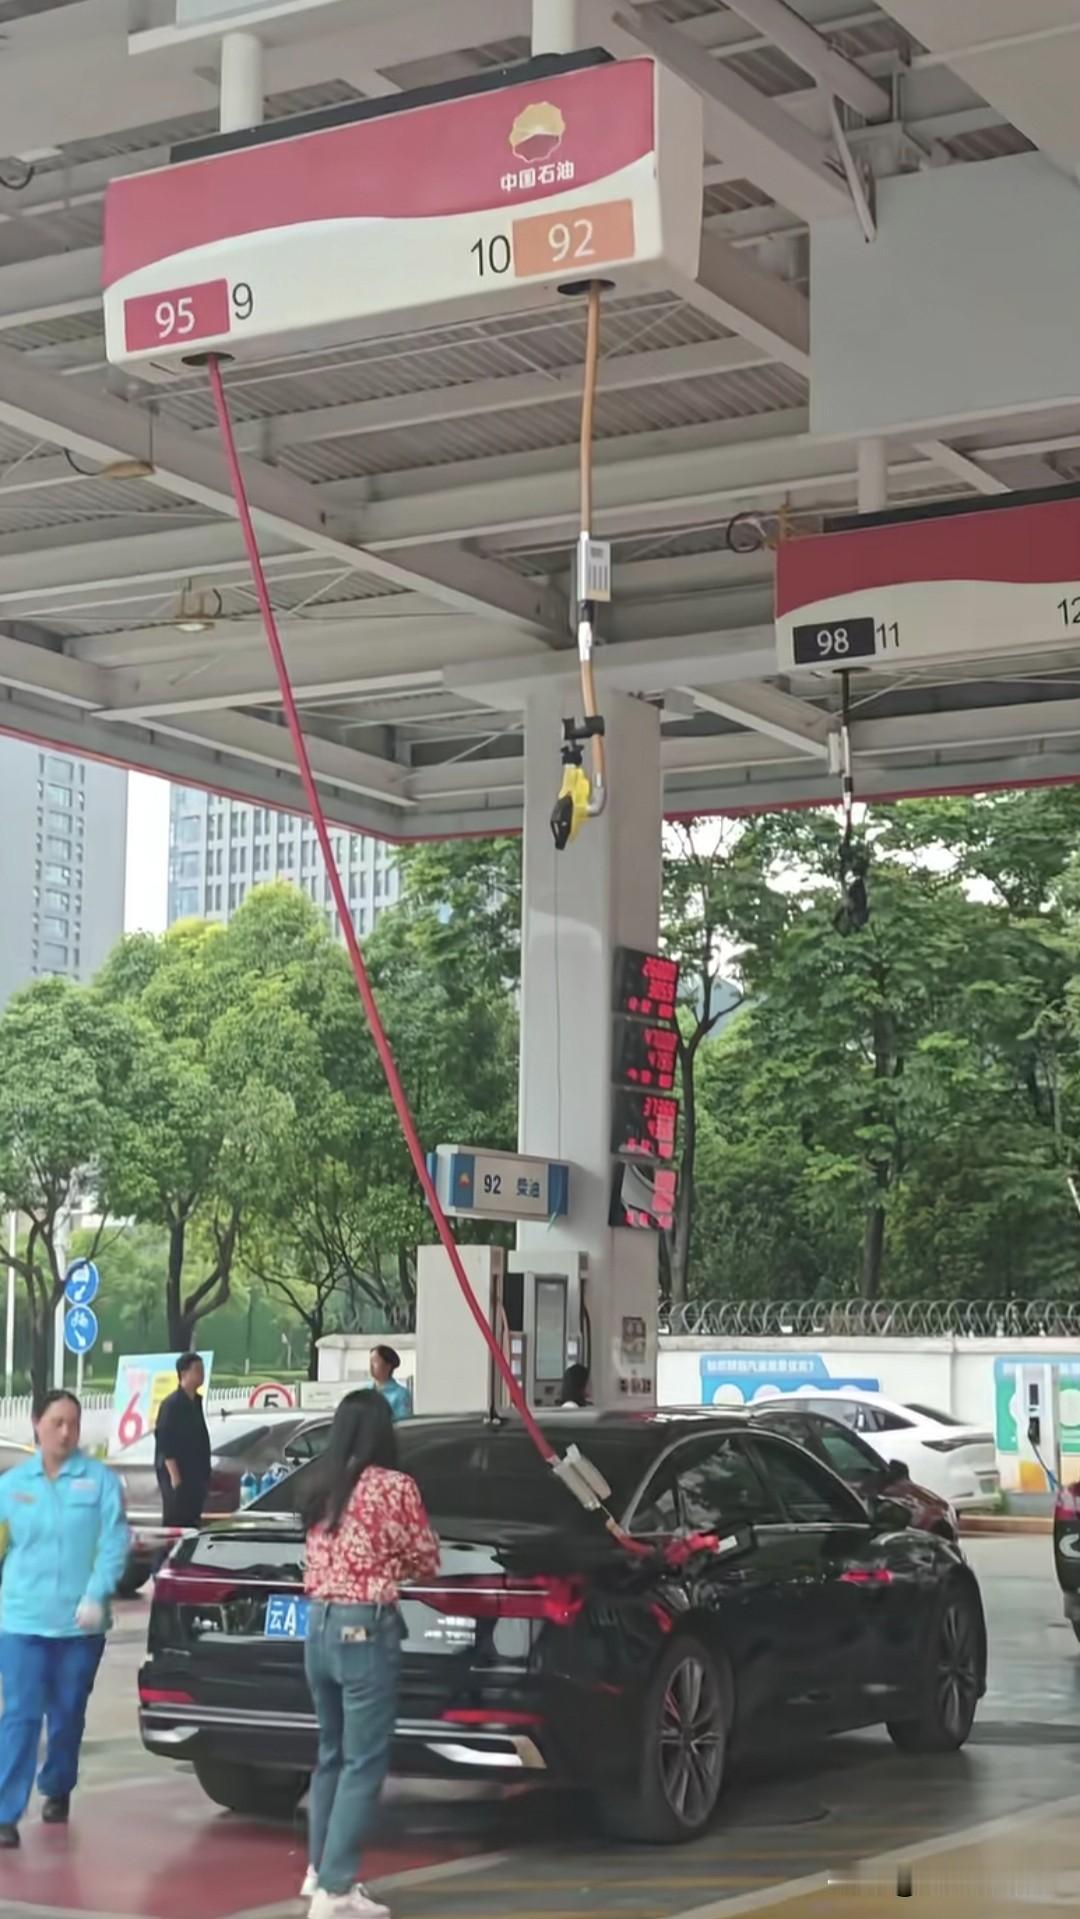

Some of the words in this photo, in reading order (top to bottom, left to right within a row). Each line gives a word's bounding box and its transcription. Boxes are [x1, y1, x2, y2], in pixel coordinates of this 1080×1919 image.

[501, 160, 574, 192] 中国石油
[470, 234, 512, 277] 10
[548, 219, 595, 262] 92
[155, 297, 195, 338] 95
[232, 283, 253, 320] 9
[816, 627, 850, 656] 98
[875, 621, 901, 649] 11
[484, 1174, 501, 1195] 92
[118, 1391, 143, 1448] 6
